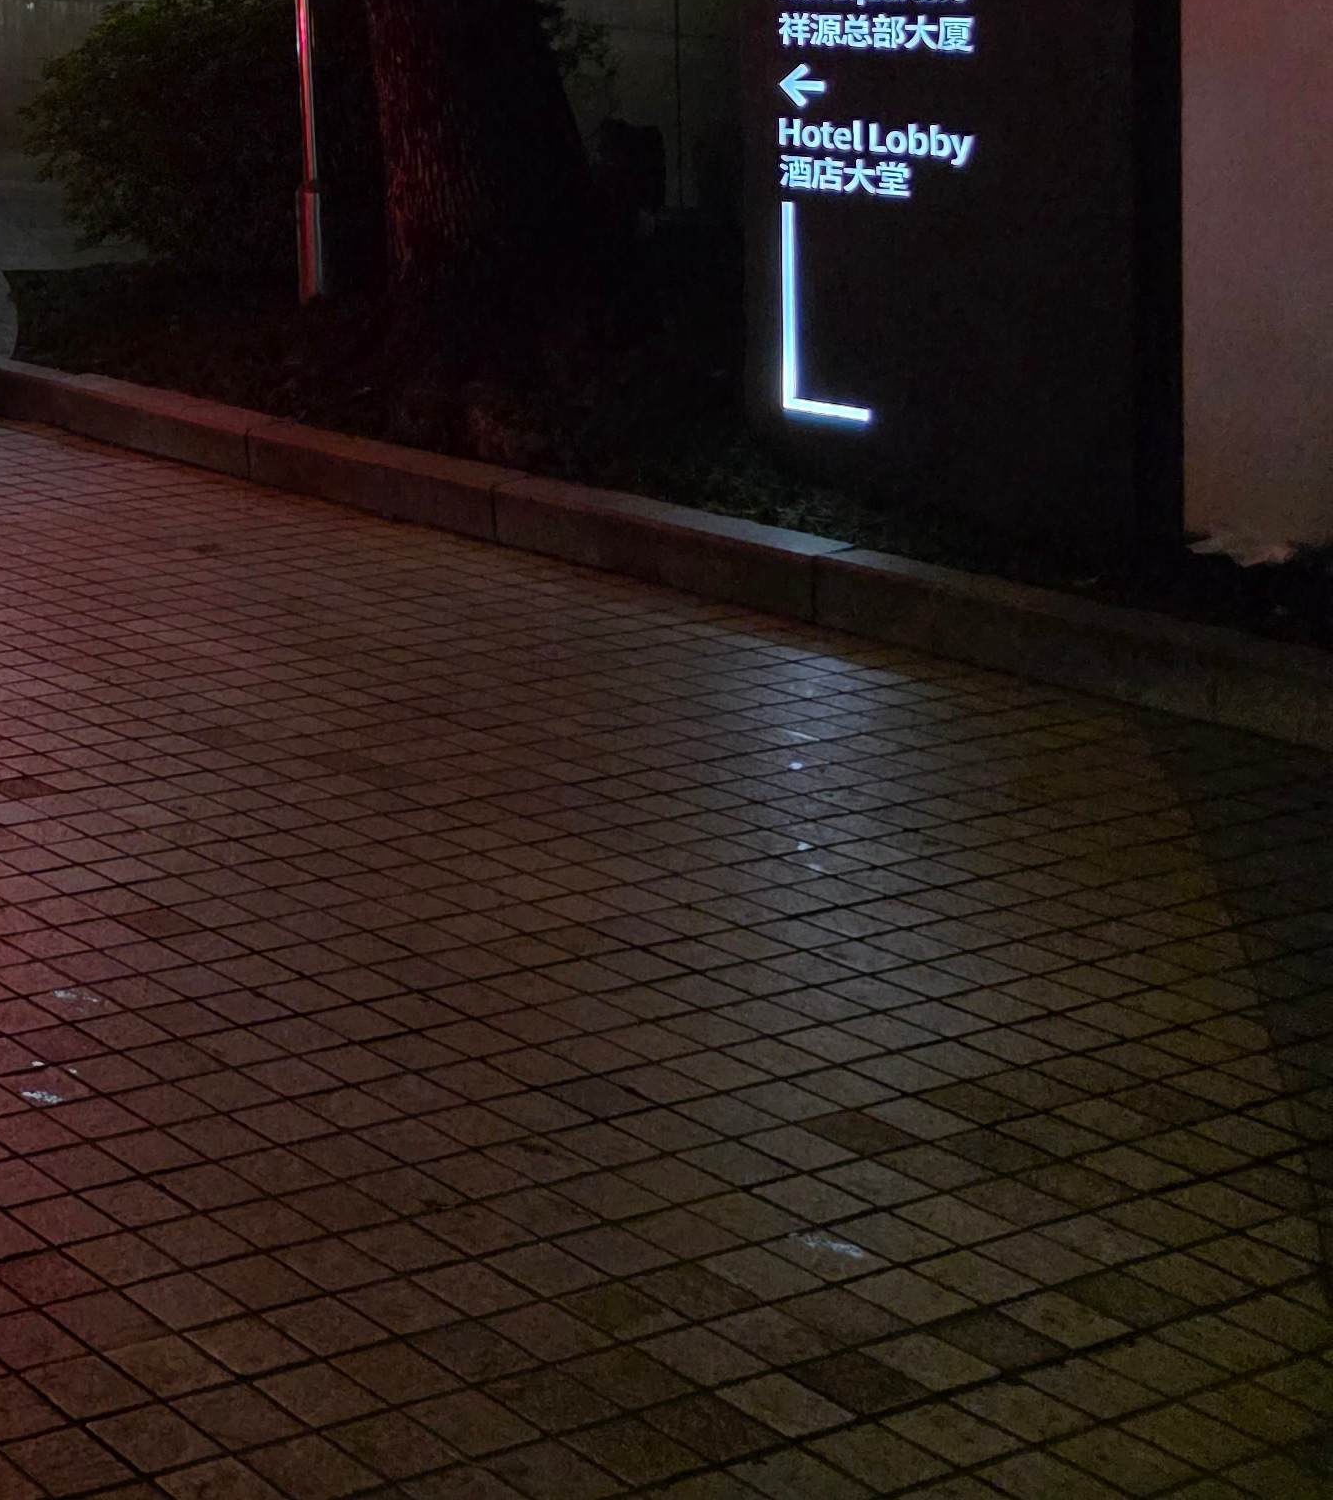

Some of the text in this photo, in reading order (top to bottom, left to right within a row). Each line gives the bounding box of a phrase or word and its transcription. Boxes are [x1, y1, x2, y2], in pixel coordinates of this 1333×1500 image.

[778, 12, 975, 52] 祥源总部大厦
[778, 117, 974, 167] Hotel Lobby
[779, 155, 912, 197] 酒店大堂
